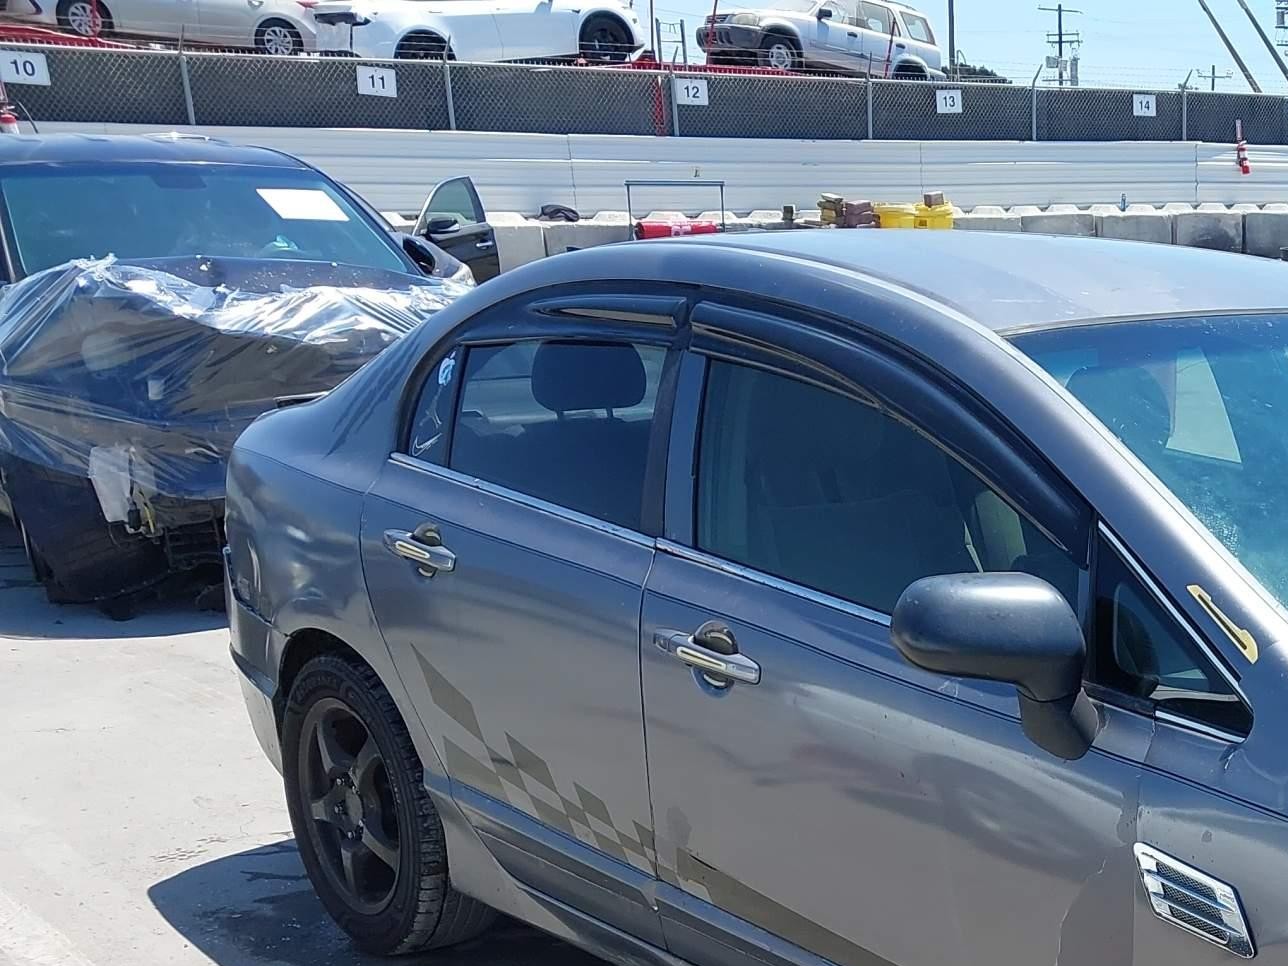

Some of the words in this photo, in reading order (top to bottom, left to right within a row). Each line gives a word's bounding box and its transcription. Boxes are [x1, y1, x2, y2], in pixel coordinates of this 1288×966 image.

[10, 59, 36, 77] 10
[368, 74, 386, 90] 11
[684, 85, 701, 99] 12
[942, 95, 956, 108] 13
[1138, 100, 1150, 112] 14
